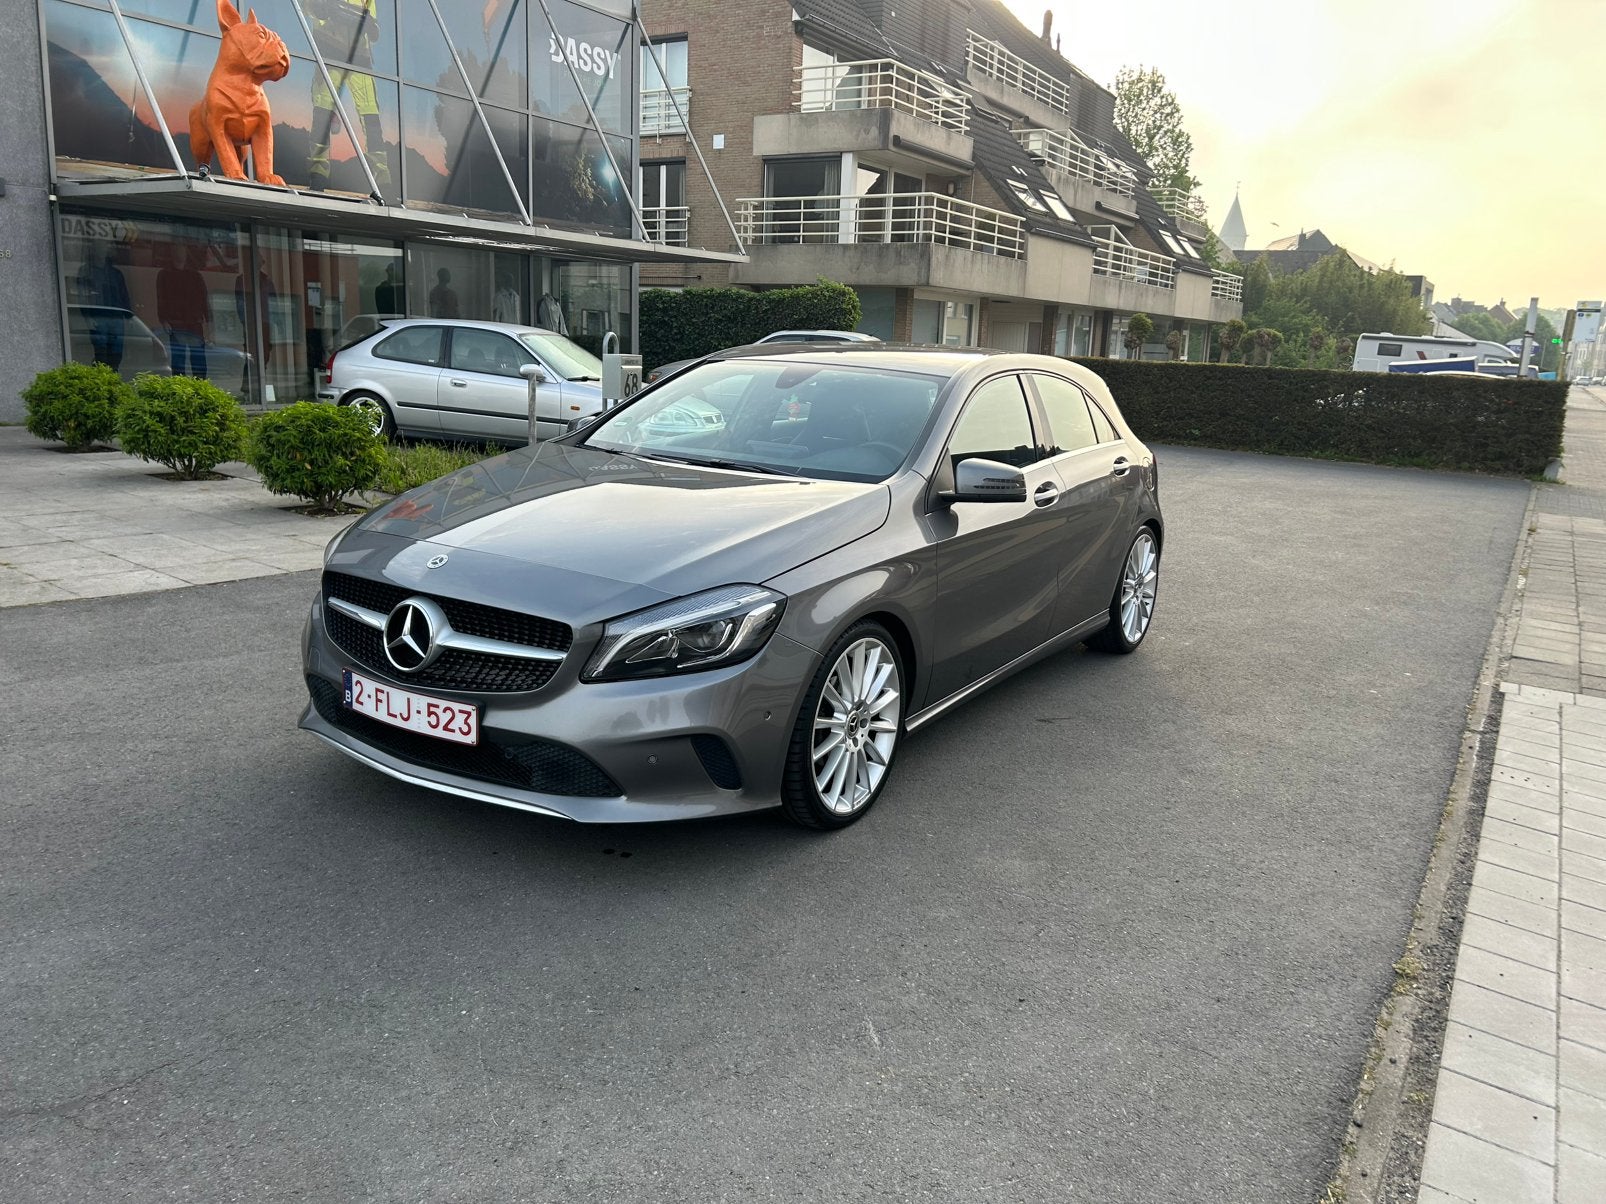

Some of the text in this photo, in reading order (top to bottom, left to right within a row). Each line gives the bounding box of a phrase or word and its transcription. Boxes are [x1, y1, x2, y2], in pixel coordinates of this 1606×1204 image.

[61, 217, 119, 239] DASSY
[624, 373, 639, 397] 68
[345, 689, 352, 702] B
